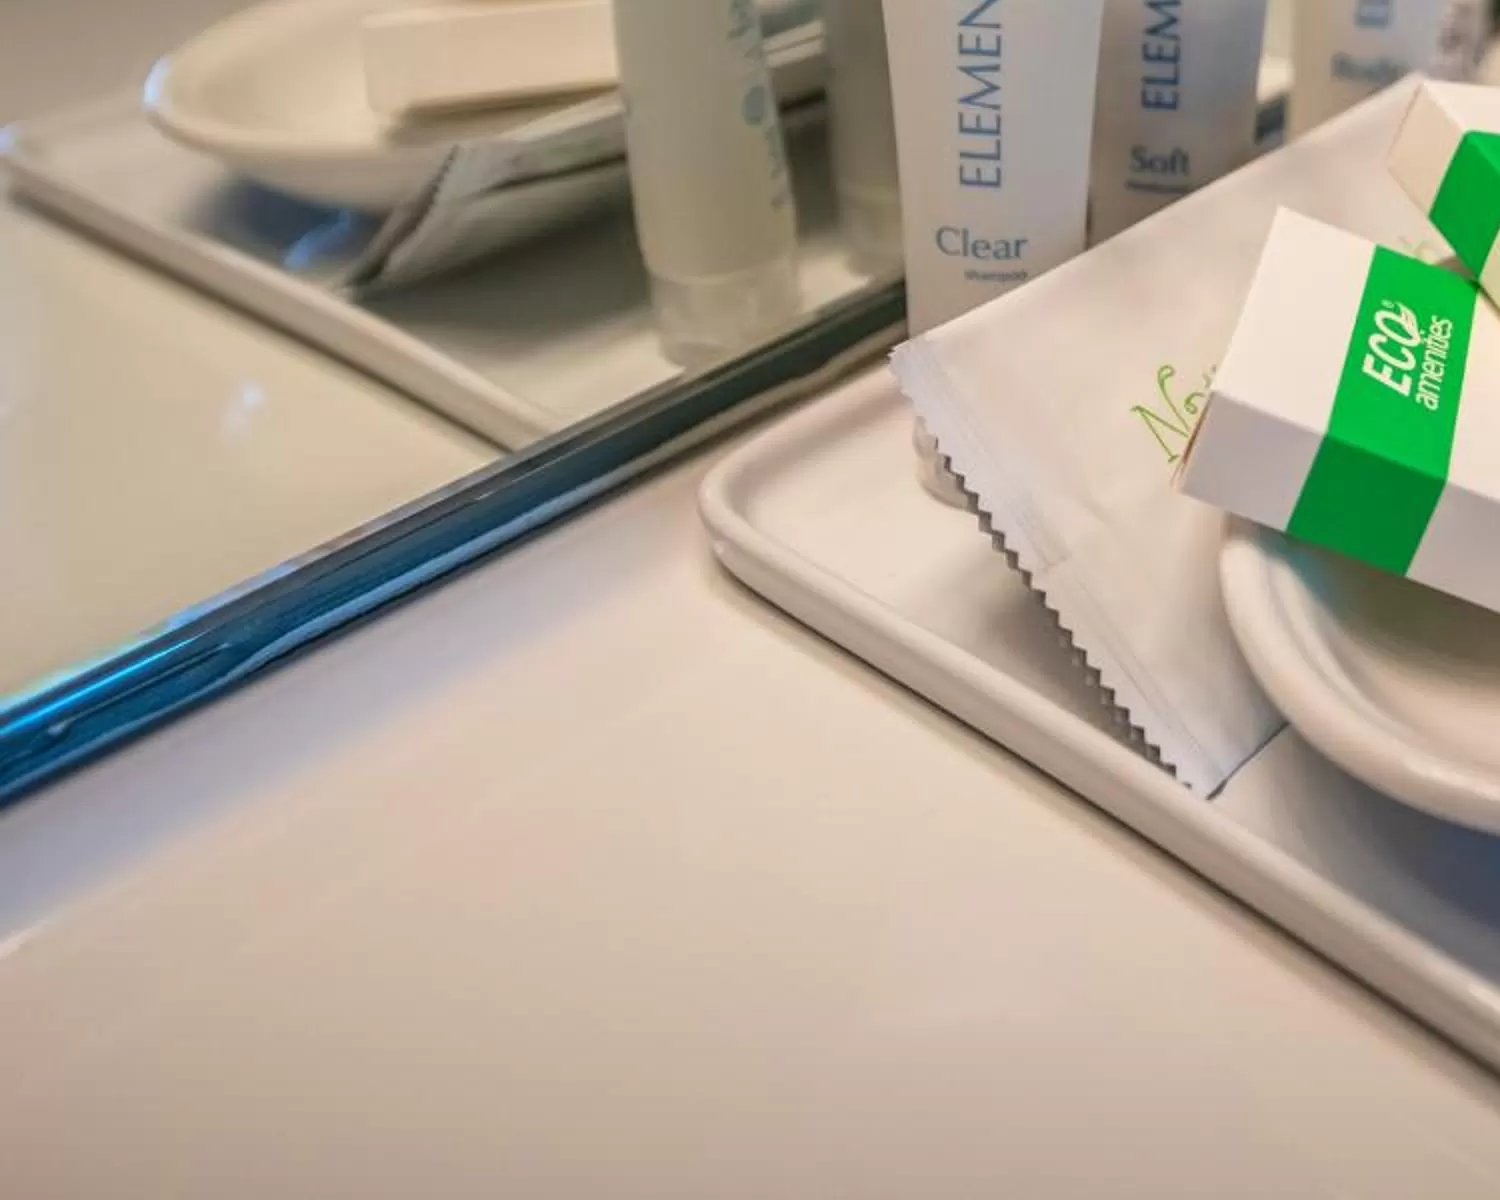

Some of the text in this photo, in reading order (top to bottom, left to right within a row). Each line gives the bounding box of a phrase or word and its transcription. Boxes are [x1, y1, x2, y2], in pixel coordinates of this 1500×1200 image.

[1130, 144, 1190, 176] Soft
[935, 225, 1029, 260] Clear
[1415, 314, 1453, 411] amenities
